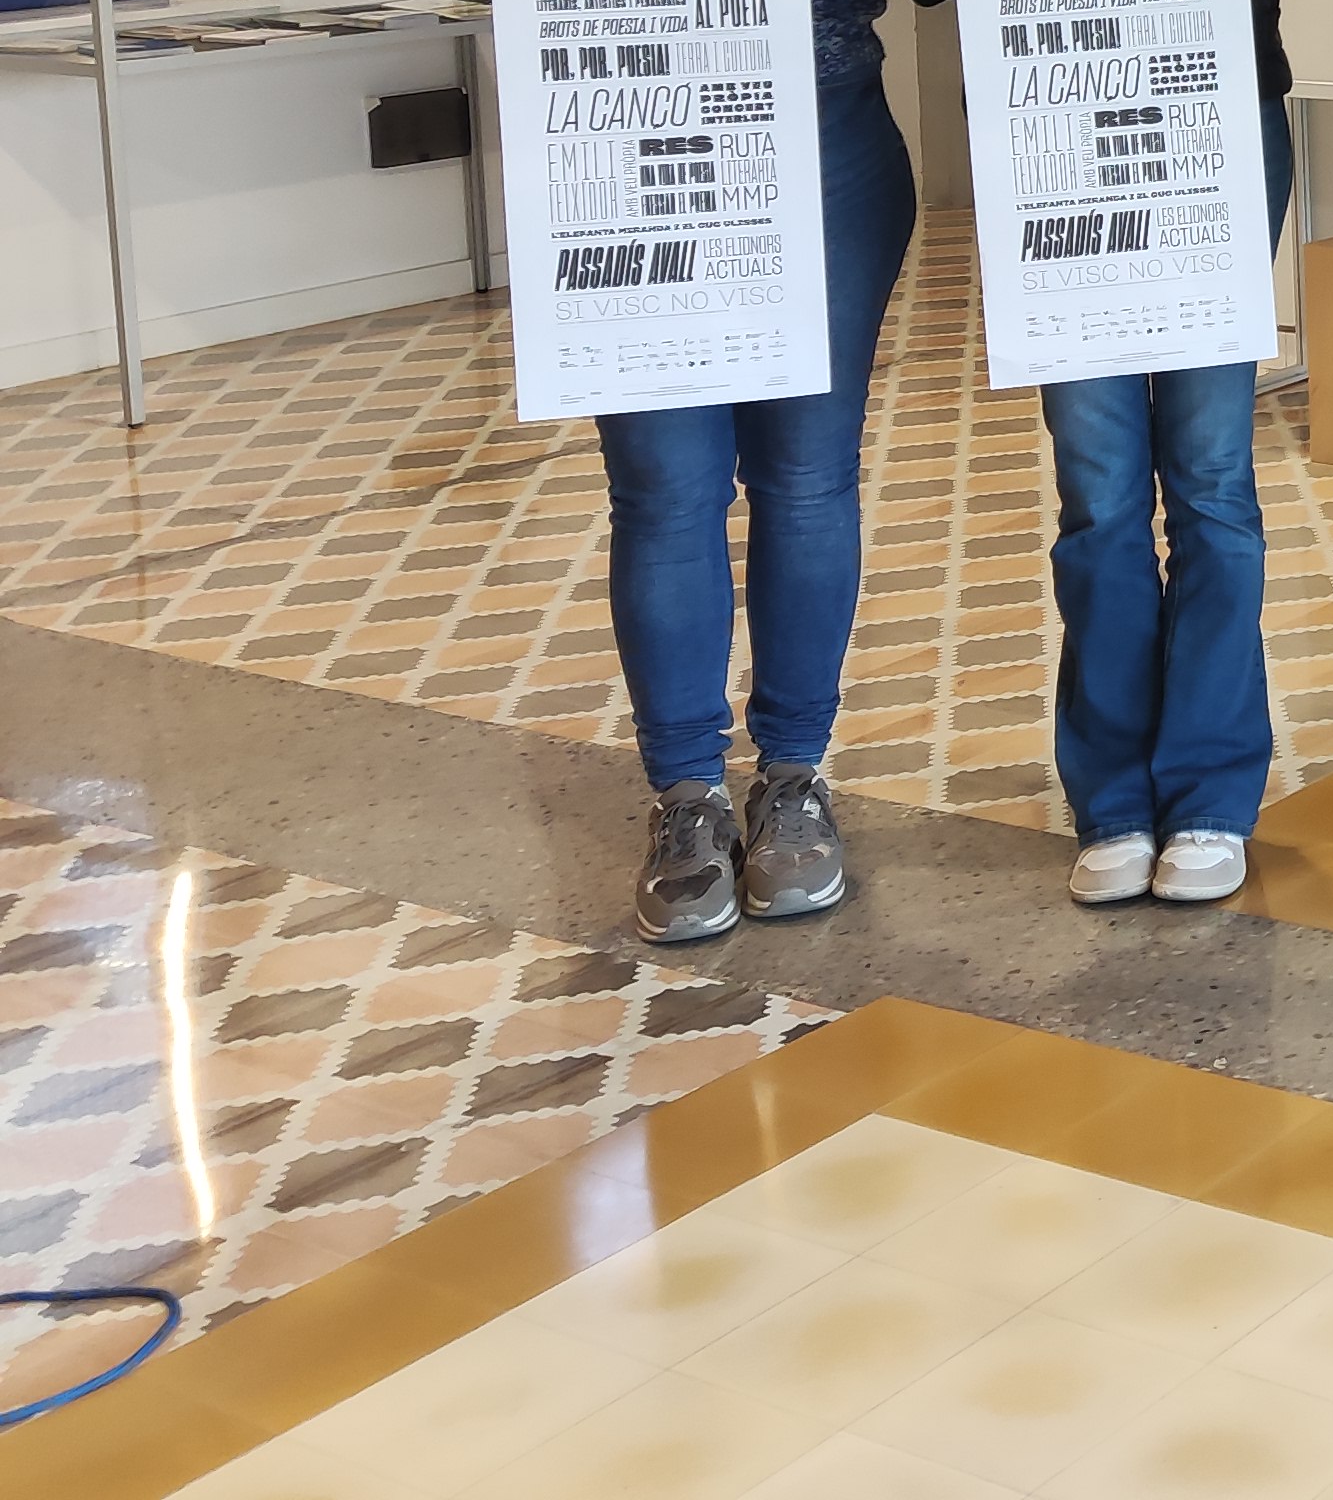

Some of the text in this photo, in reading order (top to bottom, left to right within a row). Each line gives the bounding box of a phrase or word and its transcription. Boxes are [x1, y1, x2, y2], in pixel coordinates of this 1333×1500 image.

[1001, 17, 1121, 57] POR, POR, POESIA!
[1008, 53, 1141, 108] LA CANÇÓ
[547, 82, 691, 133] LA CANÇÓ
[720, 132, 776, 159] RUTA
[722, 183, 778, 211] MMP
[1021, 208, 1151, 262] PASSADÍS AVALL
